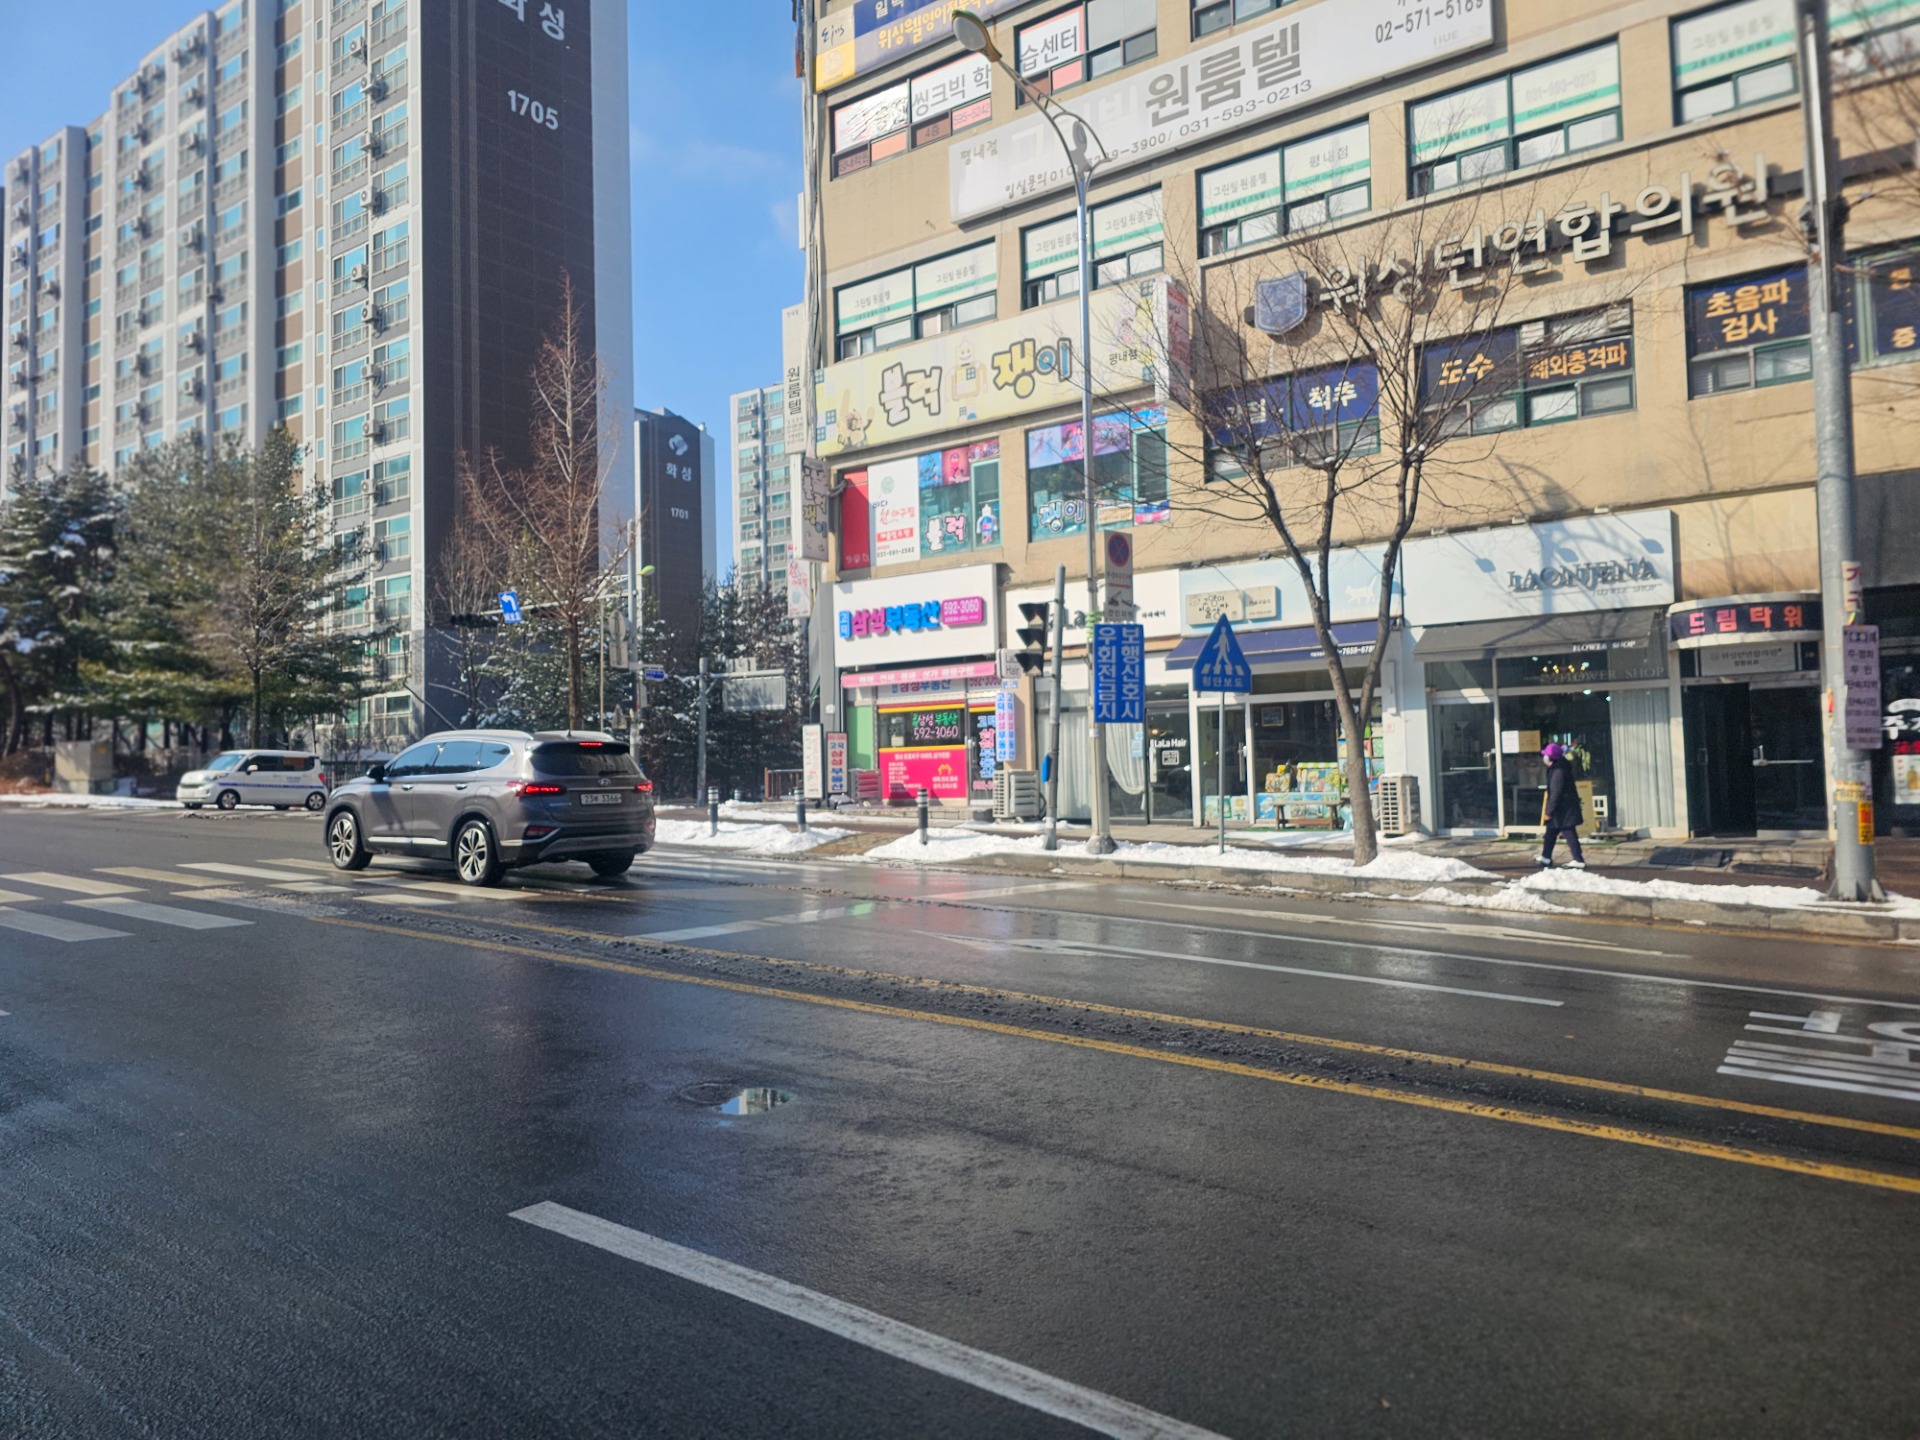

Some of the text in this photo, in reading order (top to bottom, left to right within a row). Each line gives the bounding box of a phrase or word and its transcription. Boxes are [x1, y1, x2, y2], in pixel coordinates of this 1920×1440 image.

[1020, 33, 1078, 72] 습센터
[1145, 22, 1302, 128] 원룸텔
[507, 89, 559, 130] 1705
[912, 73, 966, 117] 씽크빅
[1179, 79, 1312, 137] 031-593-0213
[960, 140, 998, 165] 평내점
[1705, 278, 1791, 318] 초음파
[1721, 309, 1779, 343] 검사
[992, 337, 1072, 399] 쟁이
[1439, 353, 1496, 386] 도수
[787, 366, 802, 415] 원룸텔
[671, 507, 689, 519] 1701
[852, 600, 940, 637] 삼성부동산
[1689, 604, 1803, 635] 드림타워
[1097, 627, 1117, 720] 우회전금지
[1121, 627, 1141, 720] 보행신호시
[913, 726, 959, 740] 592-3060
[1171, 738, 1188, 748] Hair
